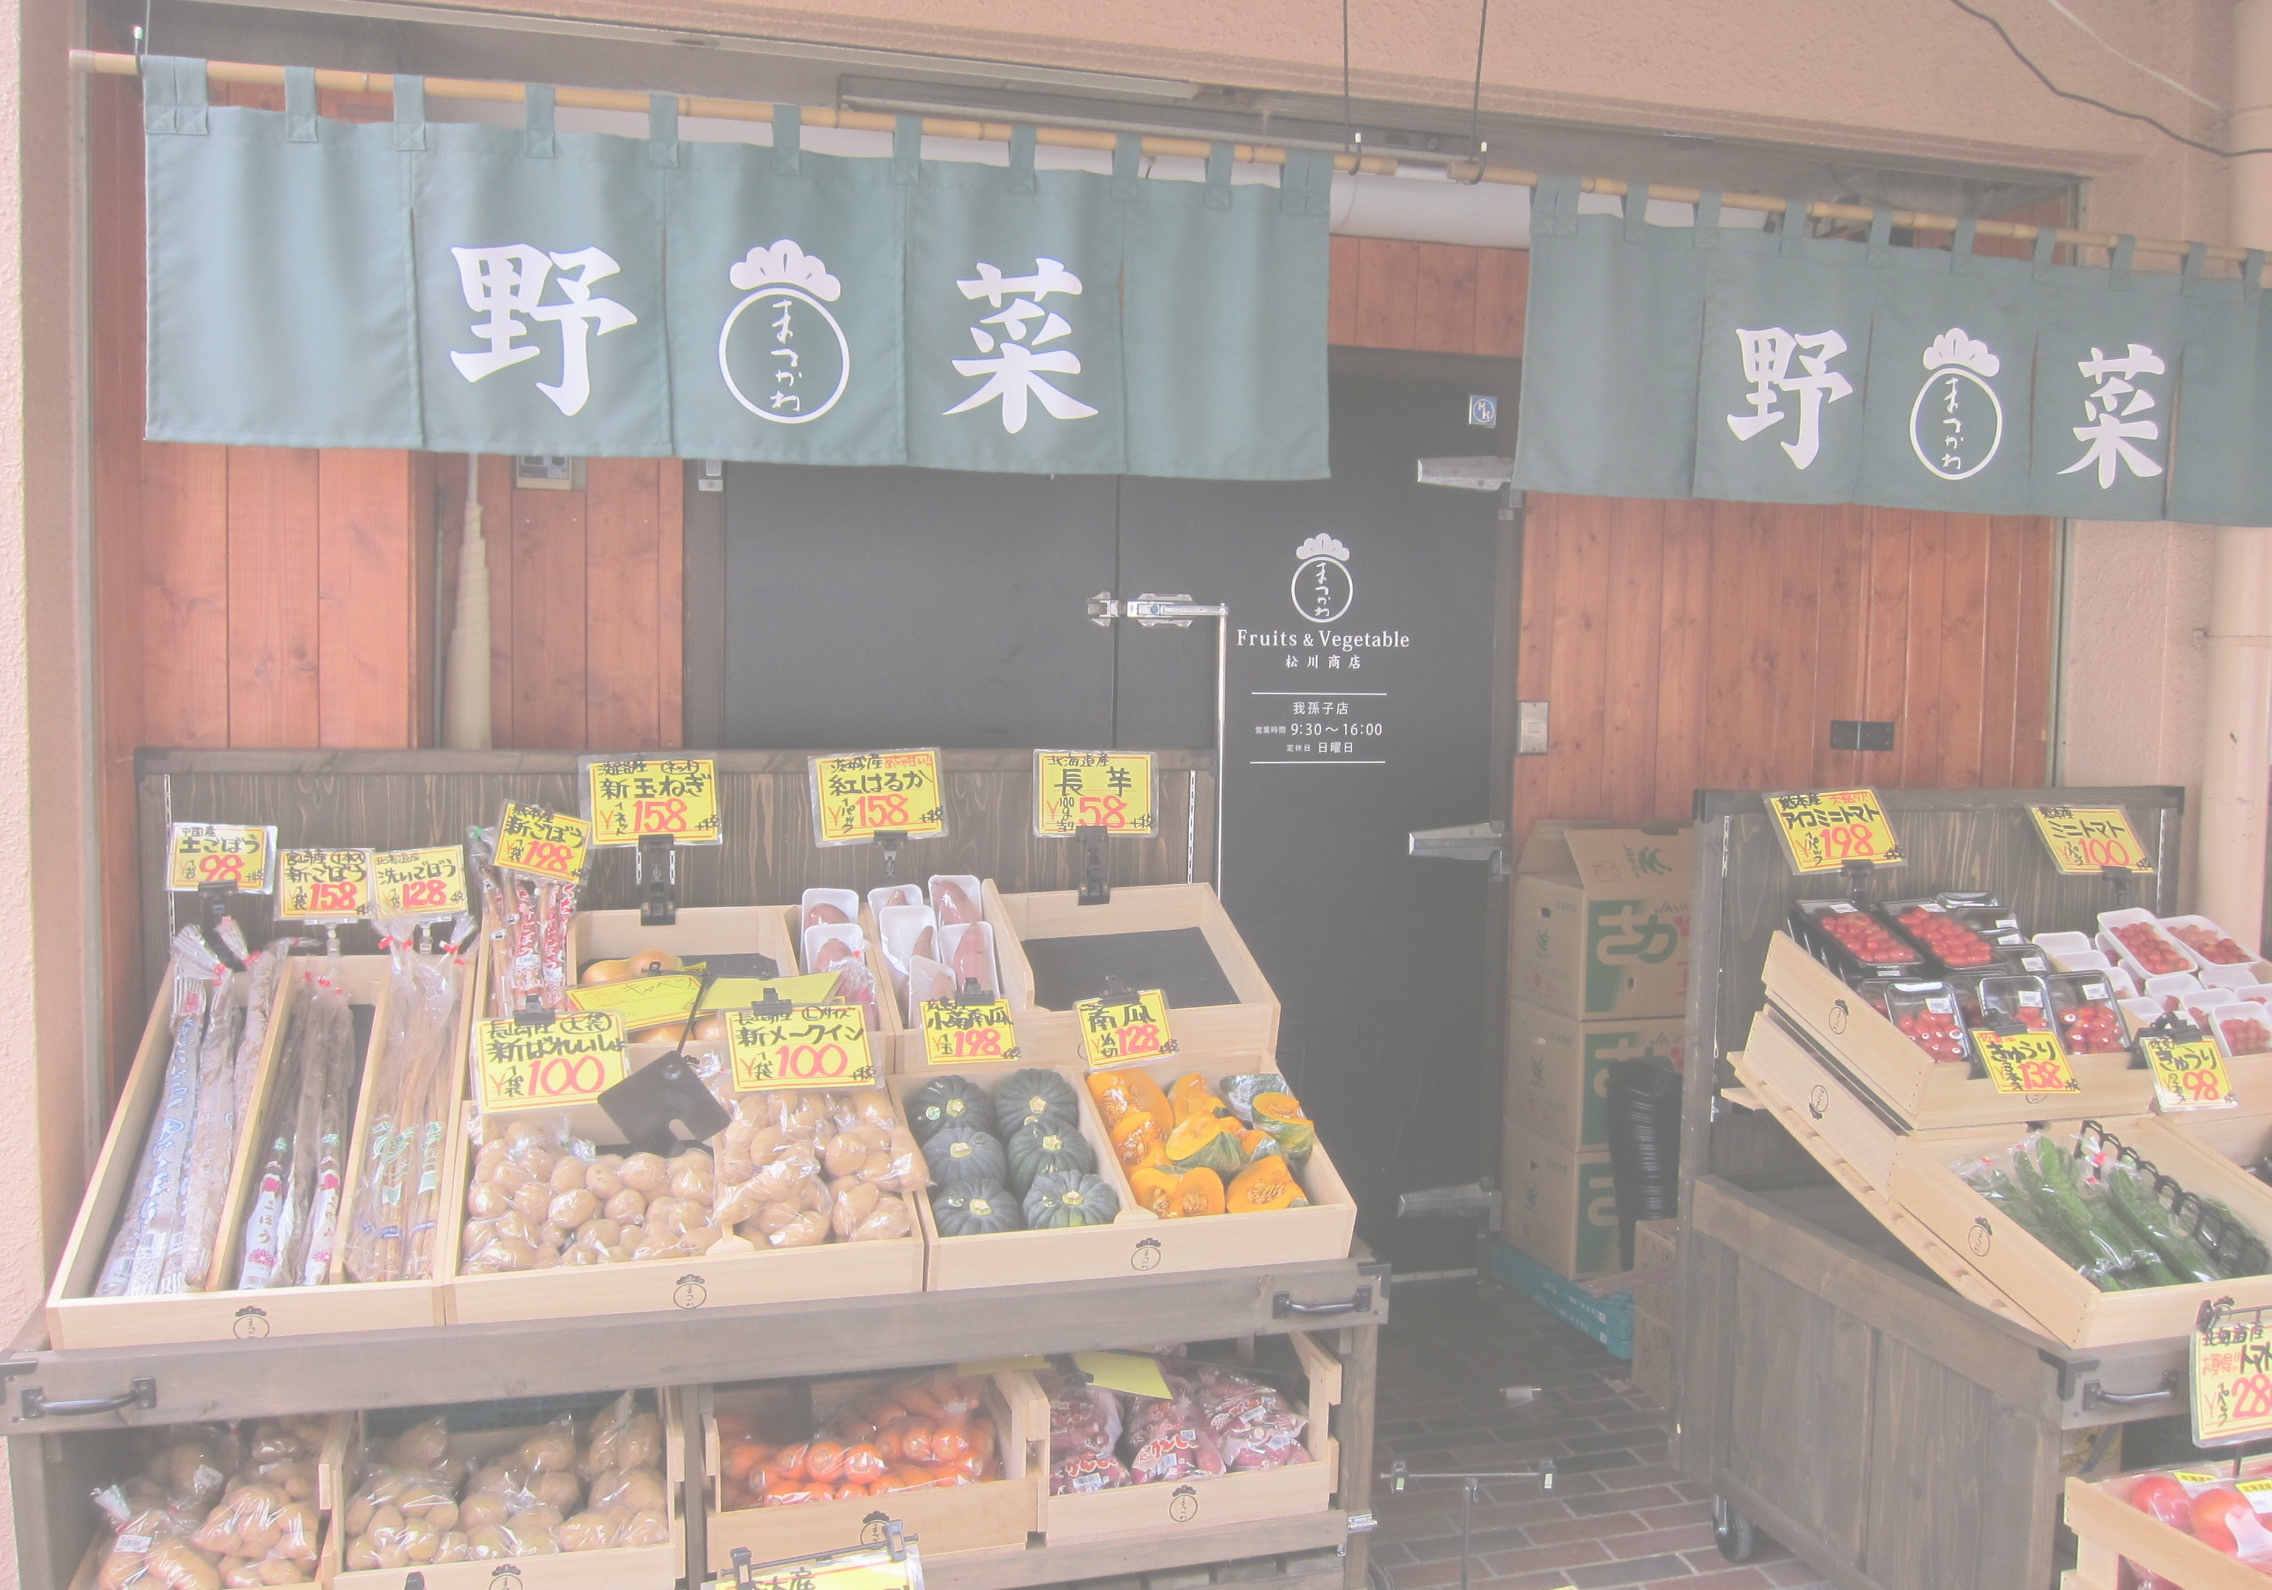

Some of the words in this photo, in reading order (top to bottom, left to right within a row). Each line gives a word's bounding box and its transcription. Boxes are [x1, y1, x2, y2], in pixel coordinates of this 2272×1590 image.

[450, 244, 638, 416] 野
[944, 256, 1099, 434] 菜
[770, 298, 802, 414] まつかわ
[1726, 326, 1853, 470] 野
[2057, 343, 2166, 490] 菜
[1941, 377, 1963, 470] まつかわ
[1236, 629, 1298, 648] Fruits
[1302, 633, 1315, 648] &
[1318, 630, 1410, 653] Vegetable
[1285, 654, 1361, 670] 松川商店
[1293, 701, 1349, 716] 我孫子店
[1254, 725, 1287, 735] 営業時間
[1047, 751, 1110, 768] 北海道産
[1286, 744, 1311, 753] 定休日
[1318, 742, 1354, 754] 日曜日
[600, 773, 712, 800] 新玉ねぎ
[828, 770, 934, 796] 紅はるか
[633, 799, 688, 832] 158
[855, 793, 909, 828] 158
[1079, 795, 1128, 829] 58
[504, 815, 582, 849] 新ごぼう
[1820, 823, 1875, 858] 198
[2048, 819, 2126, 839] ミニトマト
[179, 834, 261, 854] 土ごぼう
[523, 840, 576, 873] 198
[2079, 838, 2130, 867] 100
[199, 854, 245, 882] 98
[284, 863, 367, 883] 新ごぼう
[378, 858, 457, 885] 洗いごぼう
[310, 881, 358, 911] 158
[402, 879, 447, 908] 128
[570, 1012, 605, 1032] 大袋
[1087, 1004, 1157, 1033] 南瓜
[487, 1034, 628, 1063] 新ばれいしょ
[735, 1024, 865, 1047] 新メークイン
[953, 1028, 1001, 1058] 198
[1114, 1024, 1160, 1056] 128
[775, 1043, 848, 1080] 100
[1986, 1041, 2056, 1063] きゅうり
[2156, 1046, 2217, 1071] きゅうり
[527, 1055, 605, 1097] 100
[2017, 1061, 2064, 1089] 138
[2182, 1069, 2219, 1102] 98
